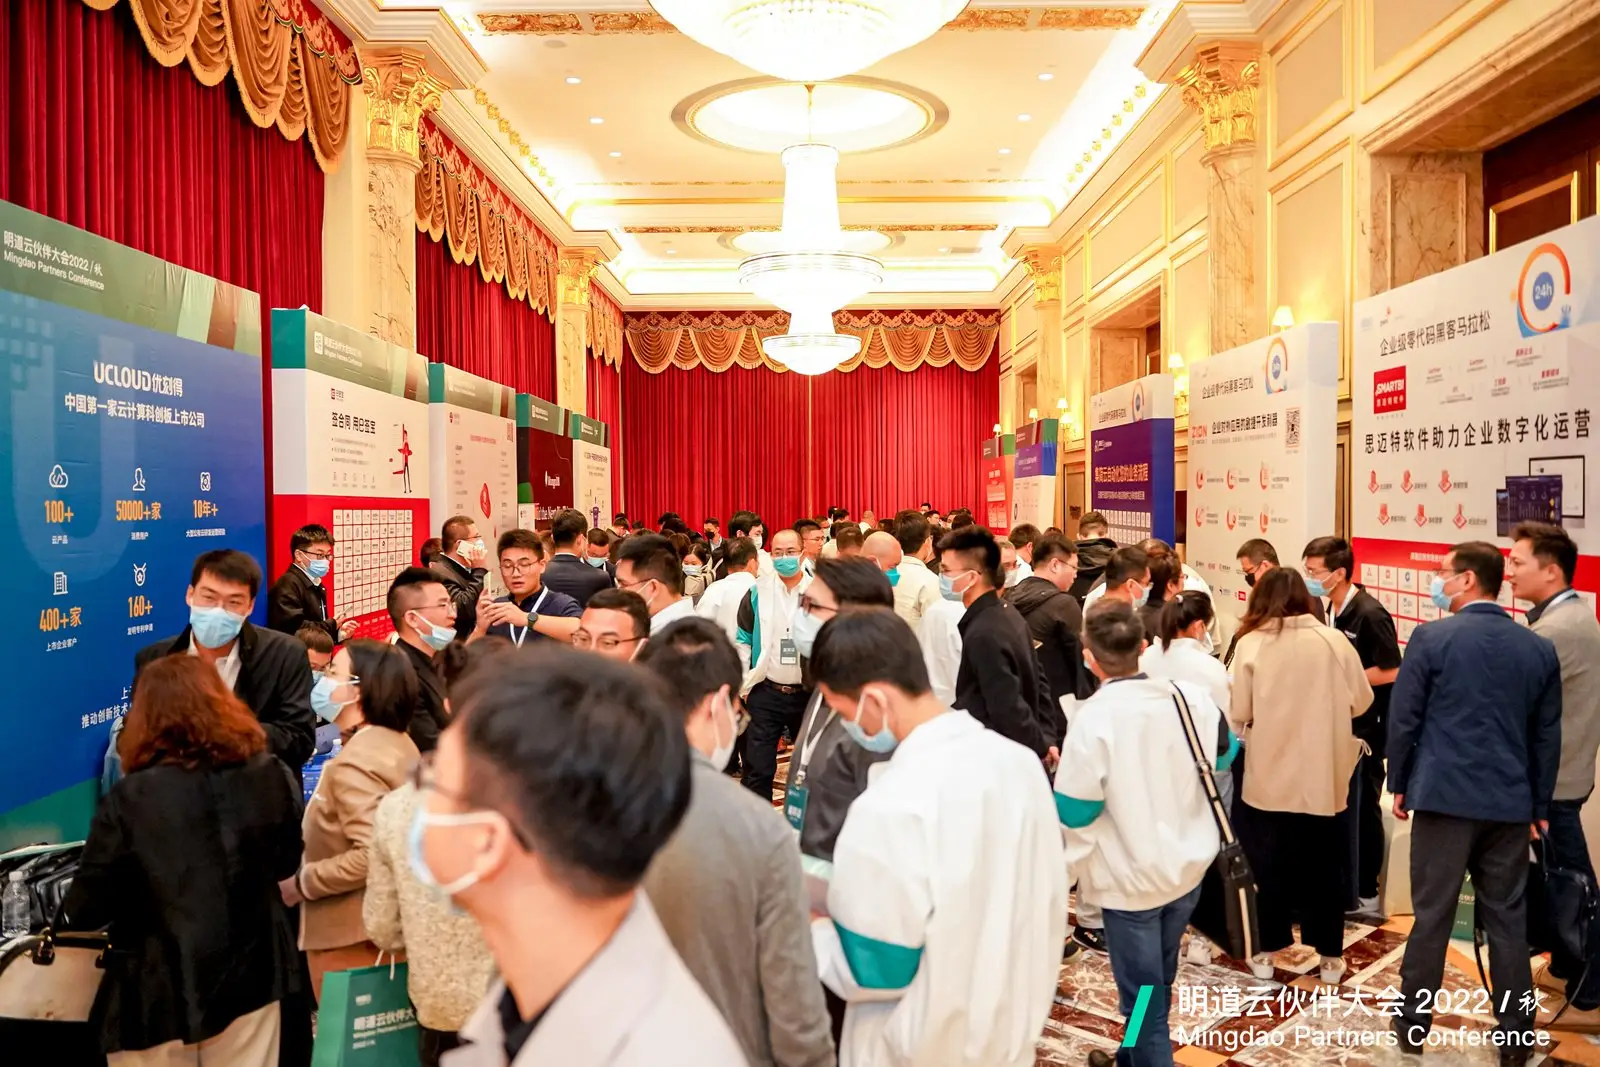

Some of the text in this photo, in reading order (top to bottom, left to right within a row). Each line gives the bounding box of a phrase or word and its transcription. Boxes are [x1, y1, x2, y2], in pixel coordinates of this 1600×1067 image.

[4, 250, 105, 290] Mingdao Partners Conference
[1534, 282, 1553, 300] 24h
[1380, 310, 1491, 357] 企业级零代码黑客马拉松
[64, 392, 205, 428] 中国第一家云计算科创板上市公司
[1365, 408, 1591, 454] 思迈特软件助力企业数字化运营
[44, 499, 75, 523] 100+
[115, 499, 162, 521] 50000+家
[193, 499, 219, 519] 10年+
[39, 606, 82, 632] 400+家
[128, 595, 153, 618] 160+
[46, 637, 77, 652] 上市企业客户
[81, 702, 132, 728] 推动创新技术
